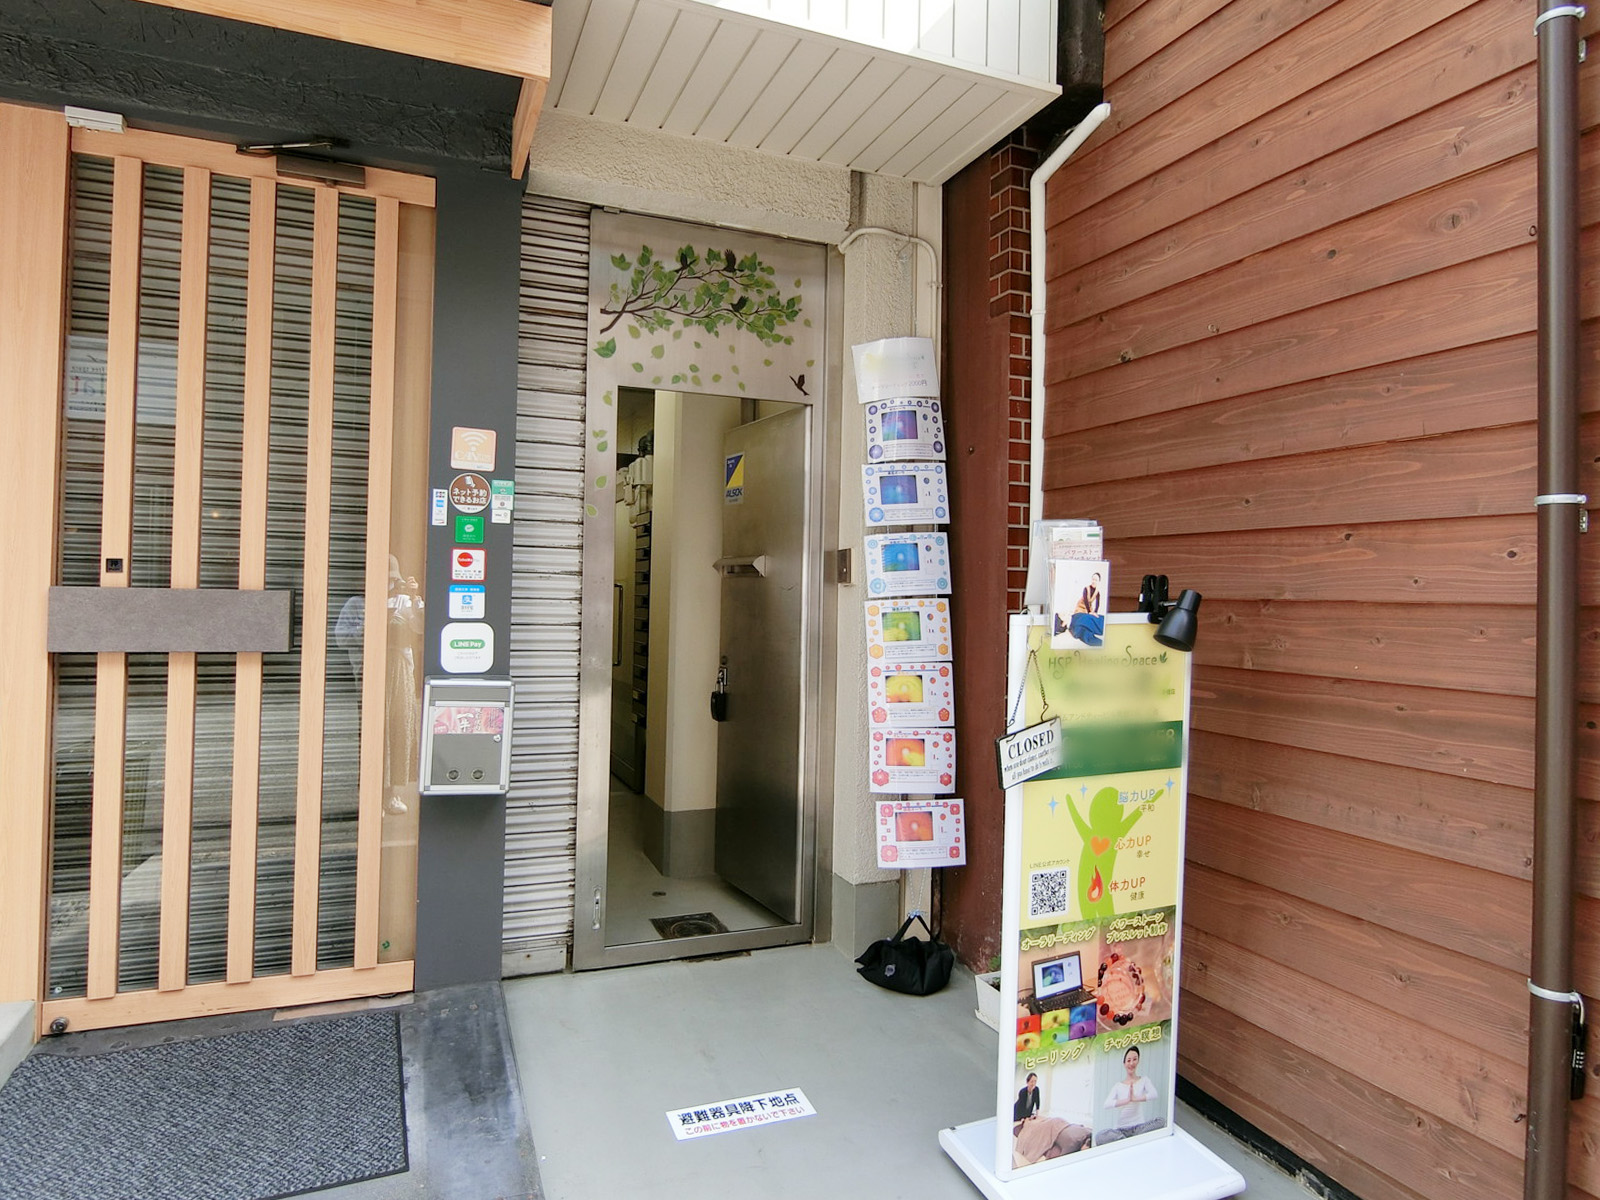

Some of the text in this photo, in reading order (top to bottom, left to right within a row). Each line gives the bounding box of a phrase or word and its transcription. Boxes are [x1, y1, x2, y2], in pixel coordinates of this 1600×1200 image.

[453, 488, 488, 497] ネット予約
[453, 496, 486, 504] できるお店
[1048, 656, 1072, 680] HSP
[1121, 646, 1158, 668] Space
[1008, 730, 1054, 760] CLOSED
[1118, 788, 1155, 804] 脳力UP
[1116, 835, 1152, 850] 心力UP
[1137, 850, 1151, 858] 幸せ
[1030, 858, 1070, 869] LINE公式アカウント
[1110, 877, 1146, 892] 体力UP
[1130, 892, 1145, 901] 健康
[1110, 914, 1164, 930] パワーストーン
[1022, 926, 1096, 950] オーラリーディング
[1106, 923, 1168, 944] ブレスレット制作
[1104, 1027, 1162, 1051] チャクラ瞑想
[1026, 1044, 1084, 1070] ヒーリング
[678, 1093, 800, 1126] 避難器具降下地点
[685, 1106, 805, 1135] この前に物を置かないで下さい
